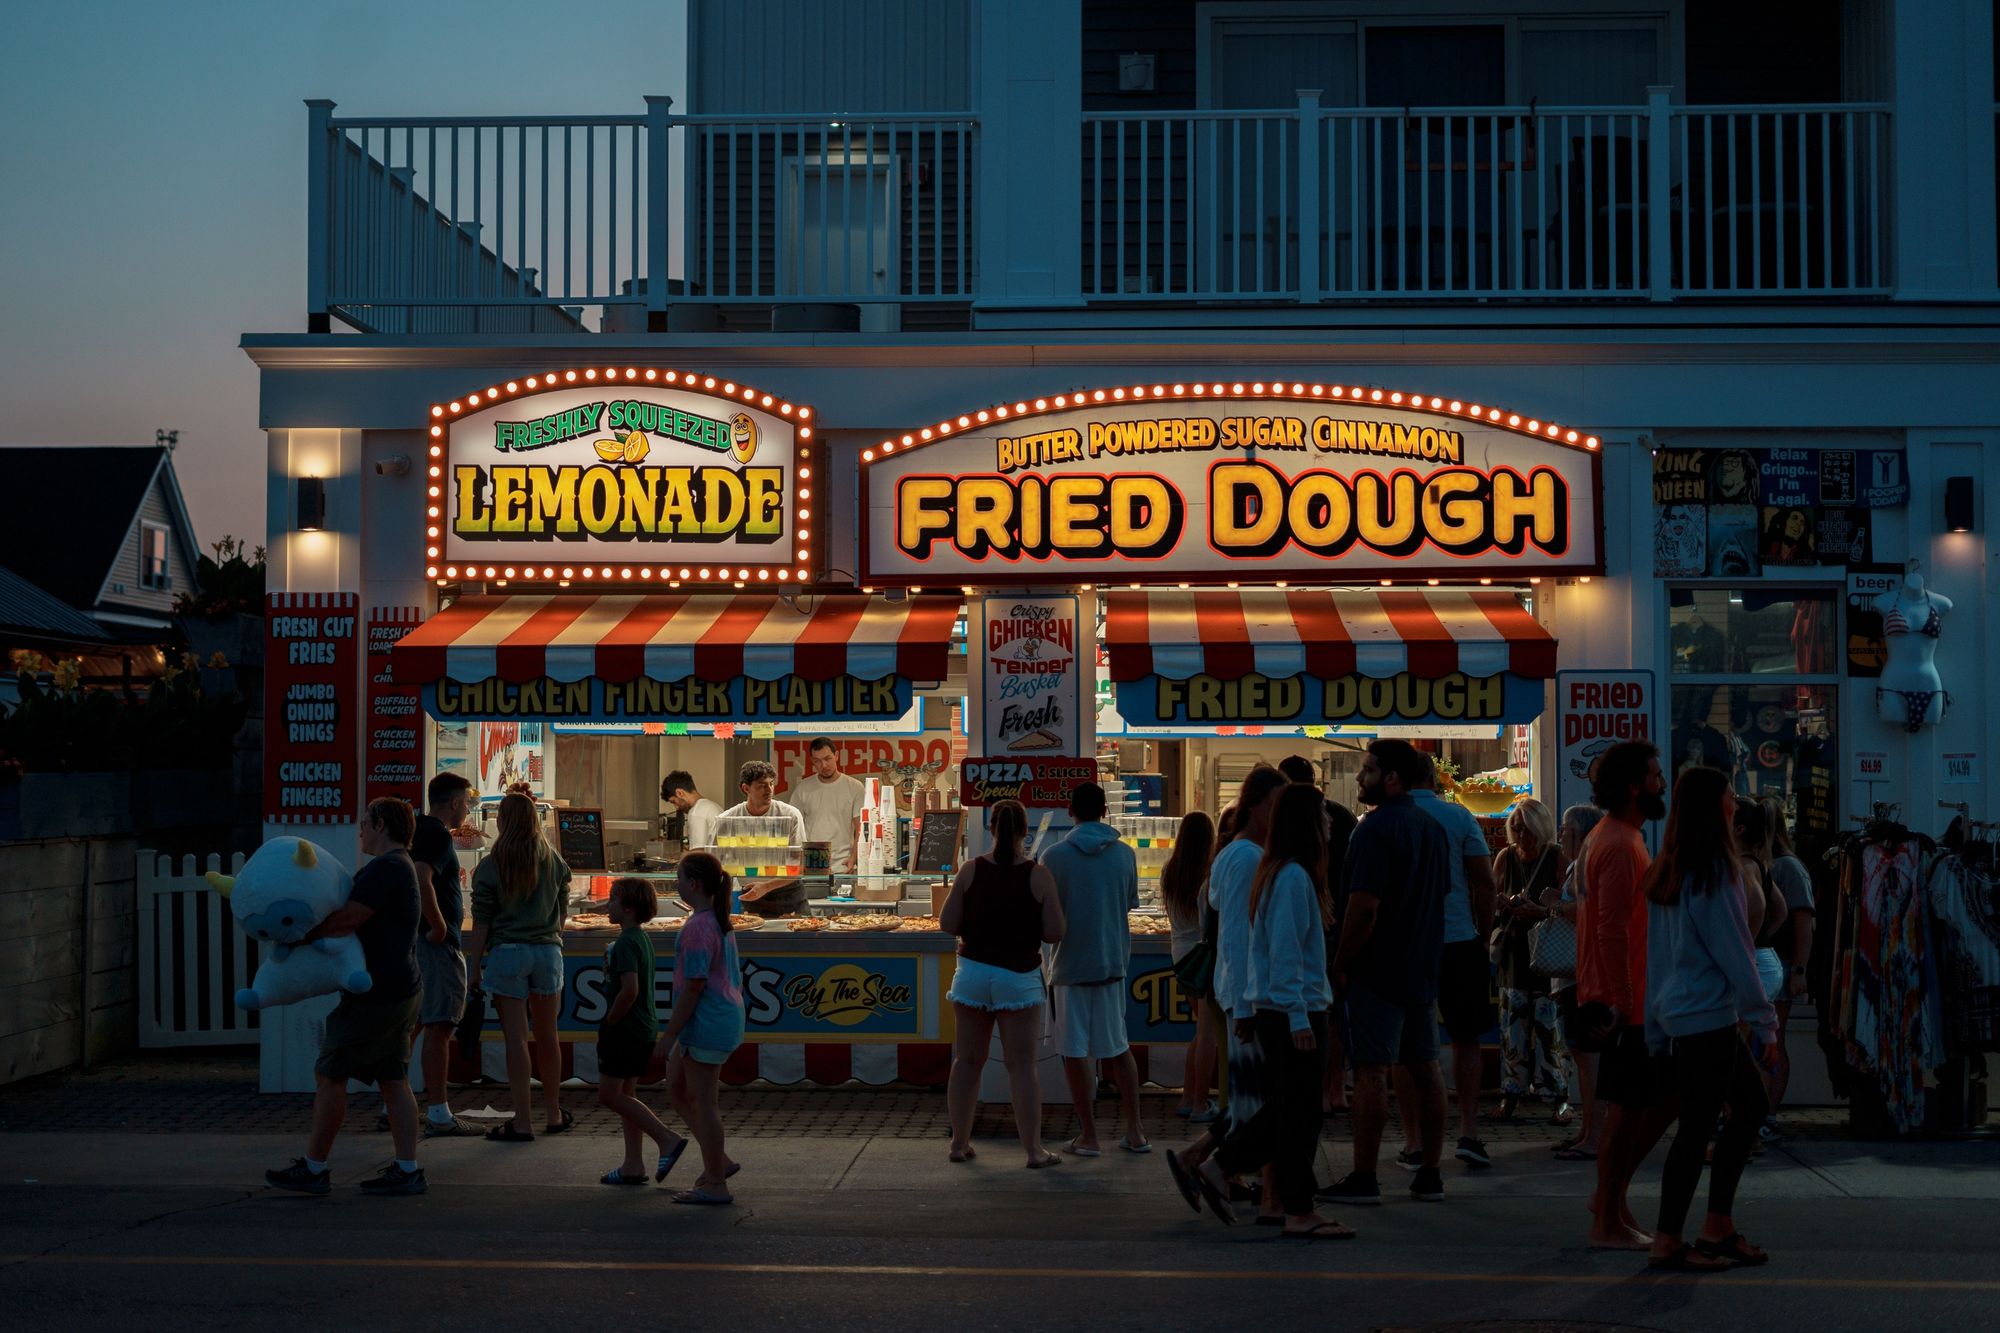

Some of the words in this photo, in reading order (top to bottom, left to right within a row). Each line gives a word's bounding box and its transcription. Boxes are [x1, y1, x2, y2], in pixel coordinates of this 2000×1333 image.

[495, 401, 606, 452] FRESHLY
[608, 399, 732, 453] SQUEEZED
[997, 428, 1083, 474] BUTTER
[1087, 419, 1219, 458] POWDERED
[1220, 417, 1307, 450] SUGAR
[1313, 416, 1464, 464] CINNAMON
[1770, 448, 1808, 461] Relax
[1761, 463, 1818, 478] Gringo...
[1779, 478, 1800, 490] I'm
[1869, 484, 1906, 498] POOPED
[453, 464, 784, 544] LEMONADE
[1769, 492, 1810, 506] Legal.
[897, 473, 1183, 561] FRIED
[1209, 459, 1569, 559] DOUGH
[1856, 576, 1896, 590] beer
[1010, 604, 1055, 620] Crispy
[271, 616, 318, 638] FRESH
[322, 616, 354, 638] CUT
[370, 626, 402, 639] FRESH
[288, 641, 336, 665] FRIES
[287, 683, 335, 700] JUMBO
[999, 673, 1064, 699] Basket
[374, 696, 417, 705] BUFFALO
[1156, 673, 1305, 720] FRIED
[1321, 673, 1504, 720] DOUGH
[287, 702, 335, 721] ONION
[374, 705, 416, 715] CHICKEN
[998, 695, 1063, 738] Fresh
[288, 722, 335, 743] RINGS
[374, 729, 416, 739] CHICKEN
[1565, 713, 1648, 747] DOUGH
[373, 739, 380, 749] &
[381, 739, 416, 749] BACON
[279, 761, 342, 783] CHICKEN
[367, 774, 394, 783] BACON
[395, 774, 421, 783] RANCH
[374, 764, 416, 774] CHICKEN
[965, 763, 1034, 783] PIZZA
[1037, 765, 1046, 778] 2
[1048, 766, 1091, 779] SLICES
[971, 780, 1025, 802] Special
[1059, 778, 1068, 788] &
[281, 785, 341, 808] FINGERS
[784, 973, 825, 1017] By
[830, 978, 860, 1003] The
[862, 972, 914, 1012] Sea
